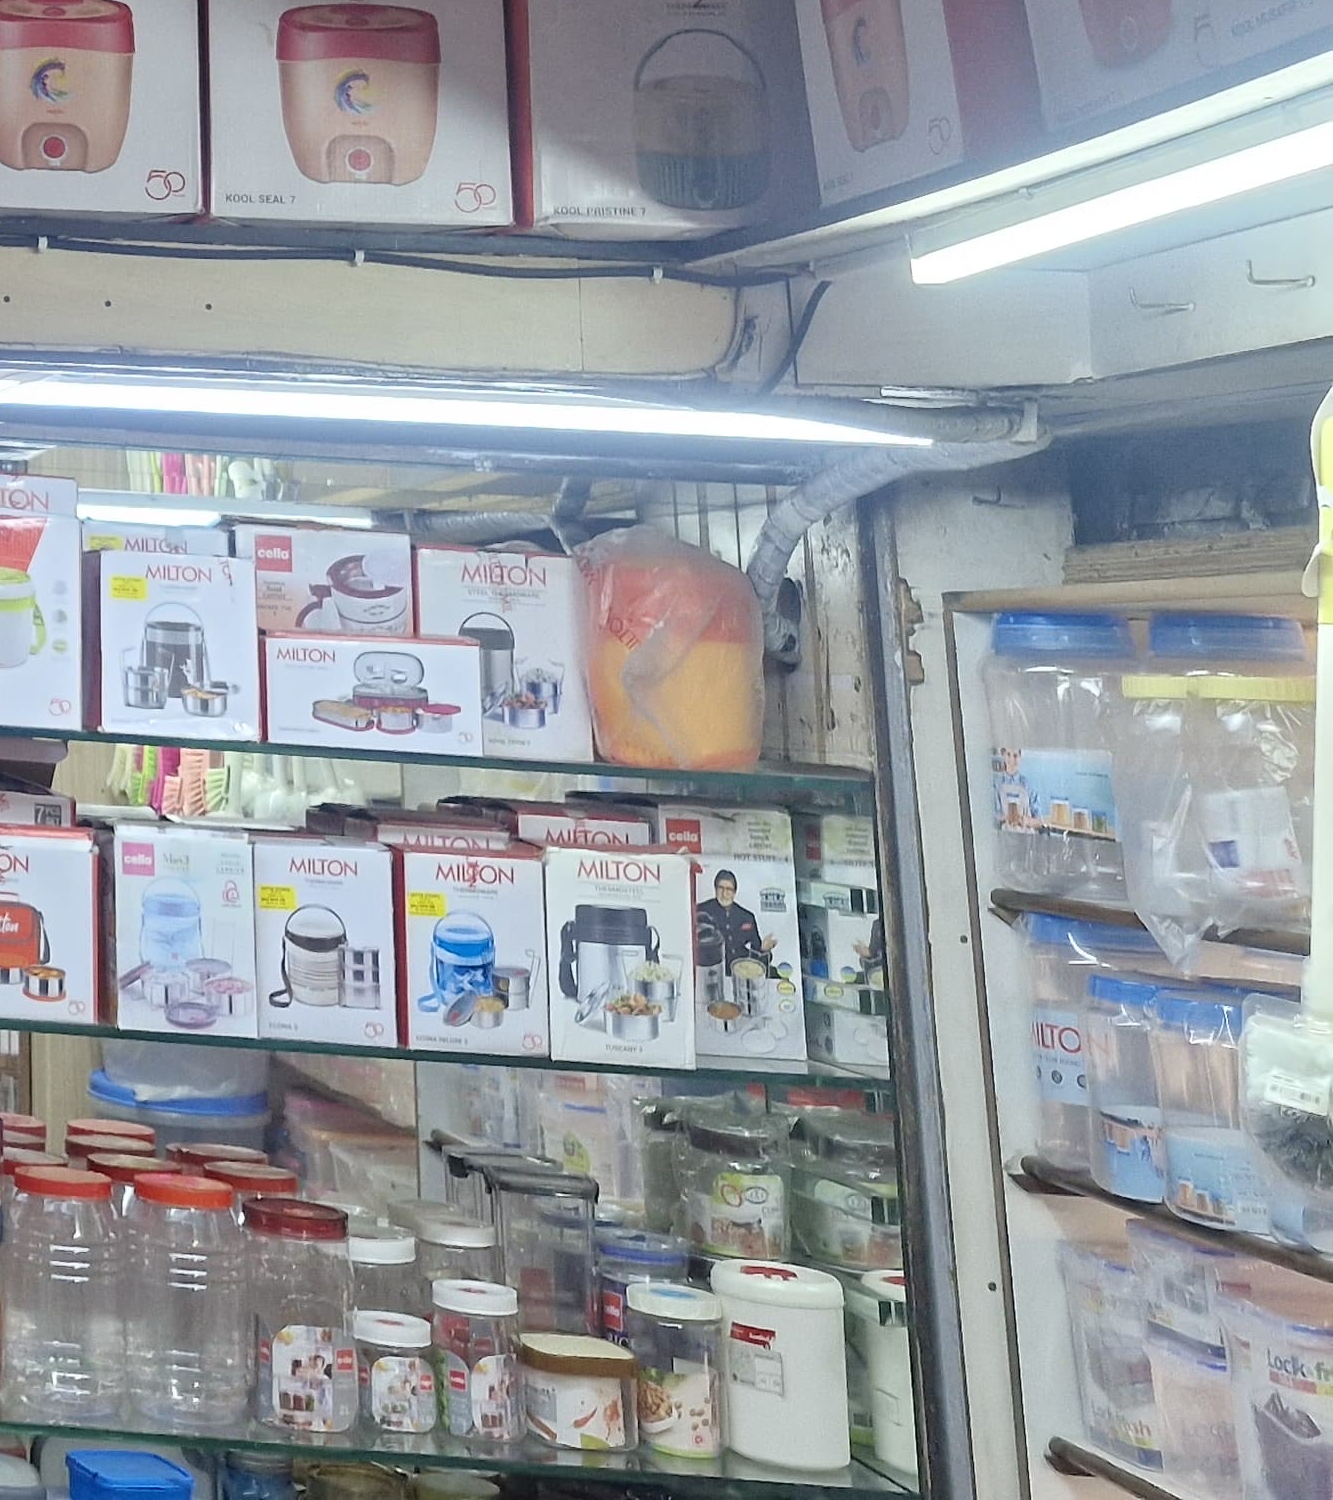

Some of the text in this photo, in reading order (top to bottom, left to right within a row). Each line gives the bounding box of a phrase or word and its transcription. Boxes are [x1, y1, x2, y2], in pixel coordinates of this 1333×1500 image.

[225, 194, 255, 204] KOOL
[257, 194, 285, 205] SEAL
[289, 195, 296, 205] 7
[257, 547, 290, 560] cello
[145, 563, 212, 583] MILTON
[461, 564, 546, 587] MILTON
[276, 648, 335, 663] MILTON
[669, 832, 698, 842] cello
[289, 858, 358, 877] MILTON
[436, 862, 514, 885] MILTON
[578, 860, 661, 883] MILTON
